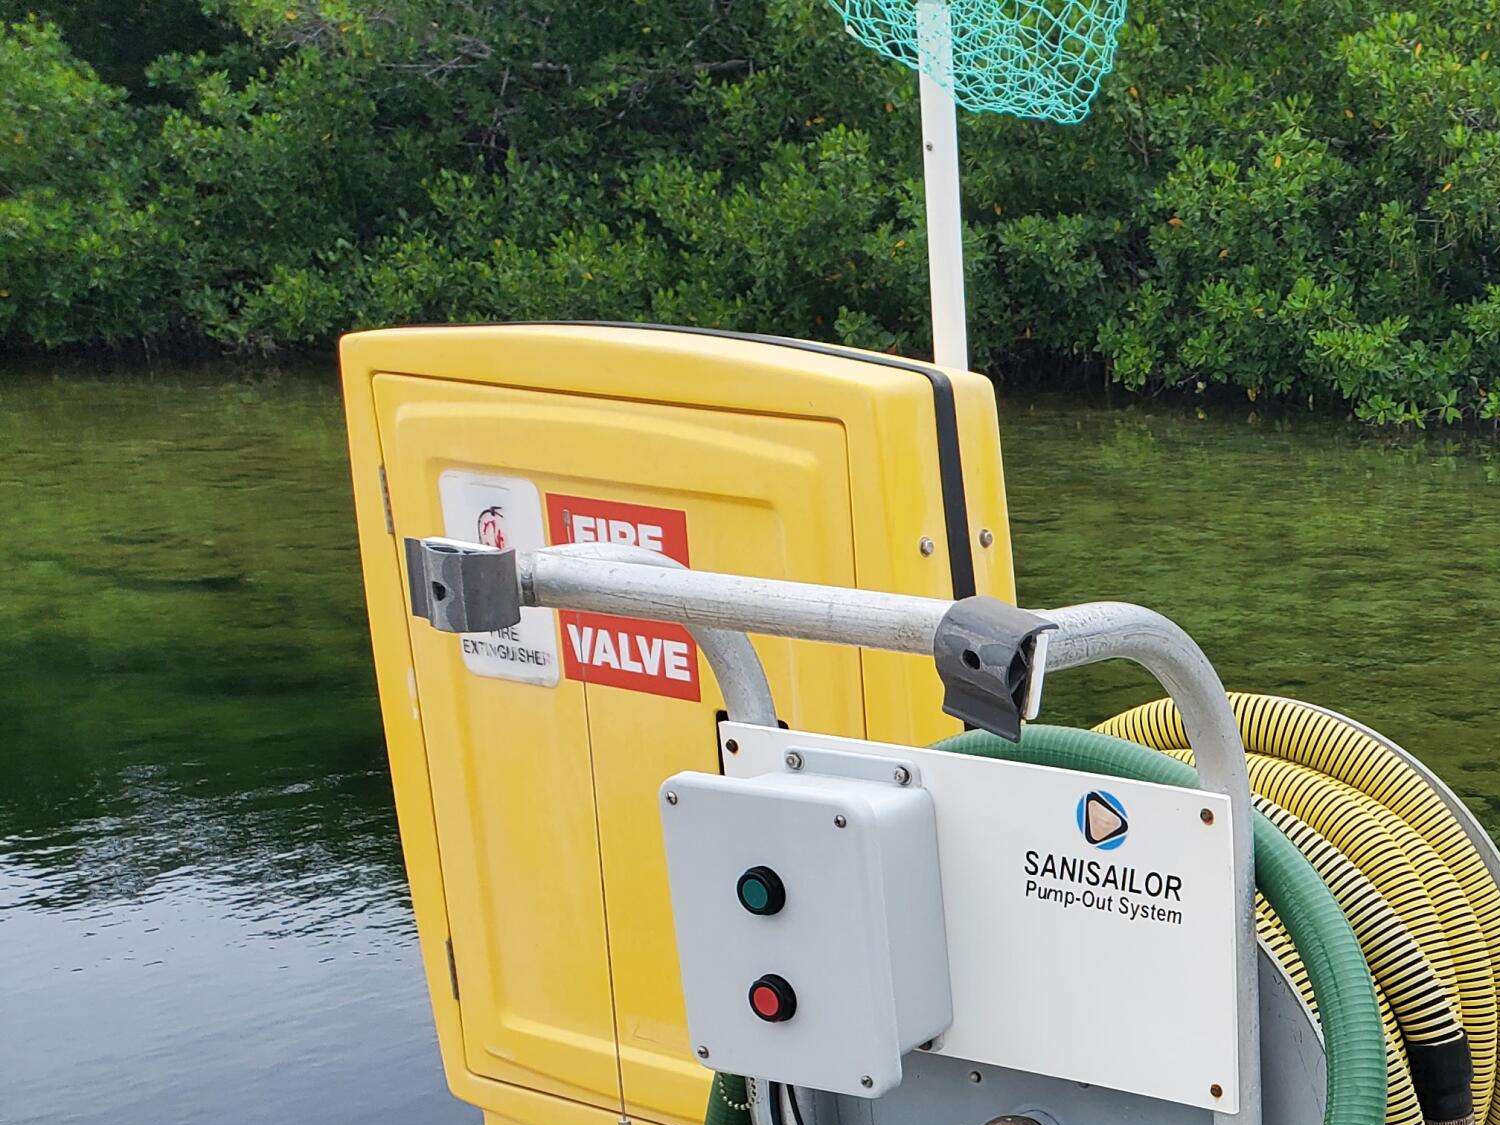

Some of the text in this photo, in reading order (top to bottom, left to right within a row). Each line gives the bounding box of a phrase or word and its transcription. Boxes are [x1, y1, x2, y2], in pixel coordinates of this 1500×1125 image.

[572, 514, 663, 551] FIRE
[566, 623, 691, 682] VALVE
[1024, 850, 1182, 901] SANISAILOR
[1025, 880, 1182, 924] Pump-Out System
